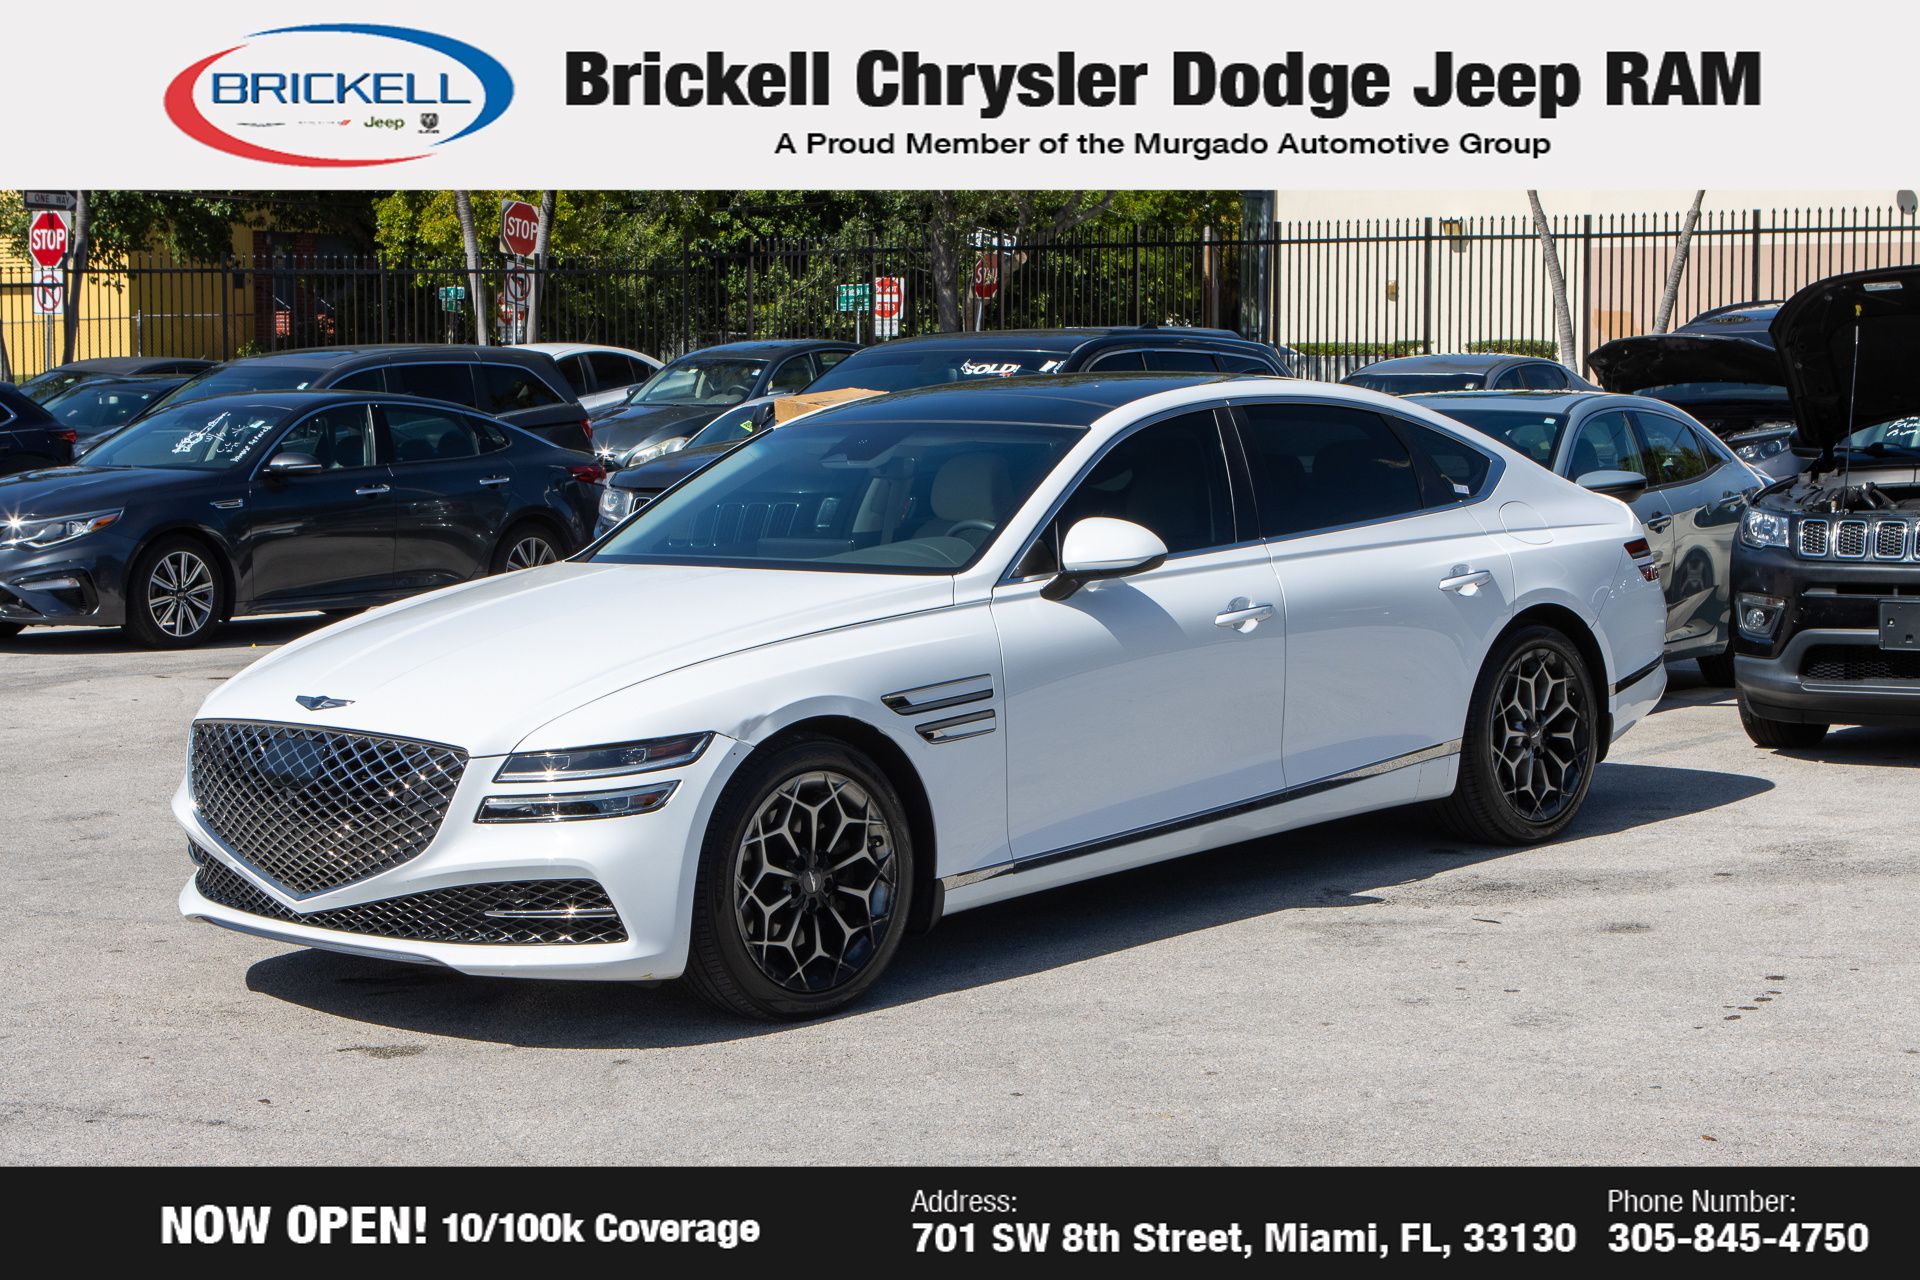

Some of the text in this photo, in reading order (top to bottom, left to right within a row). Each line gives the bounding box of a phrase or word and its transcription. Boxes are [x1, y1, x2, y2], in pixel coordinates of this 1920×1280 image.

[34, 193, 49, 203] ONE
[32, 228, 65, 250] STOP
[506, 216, 538, 240] STOP
